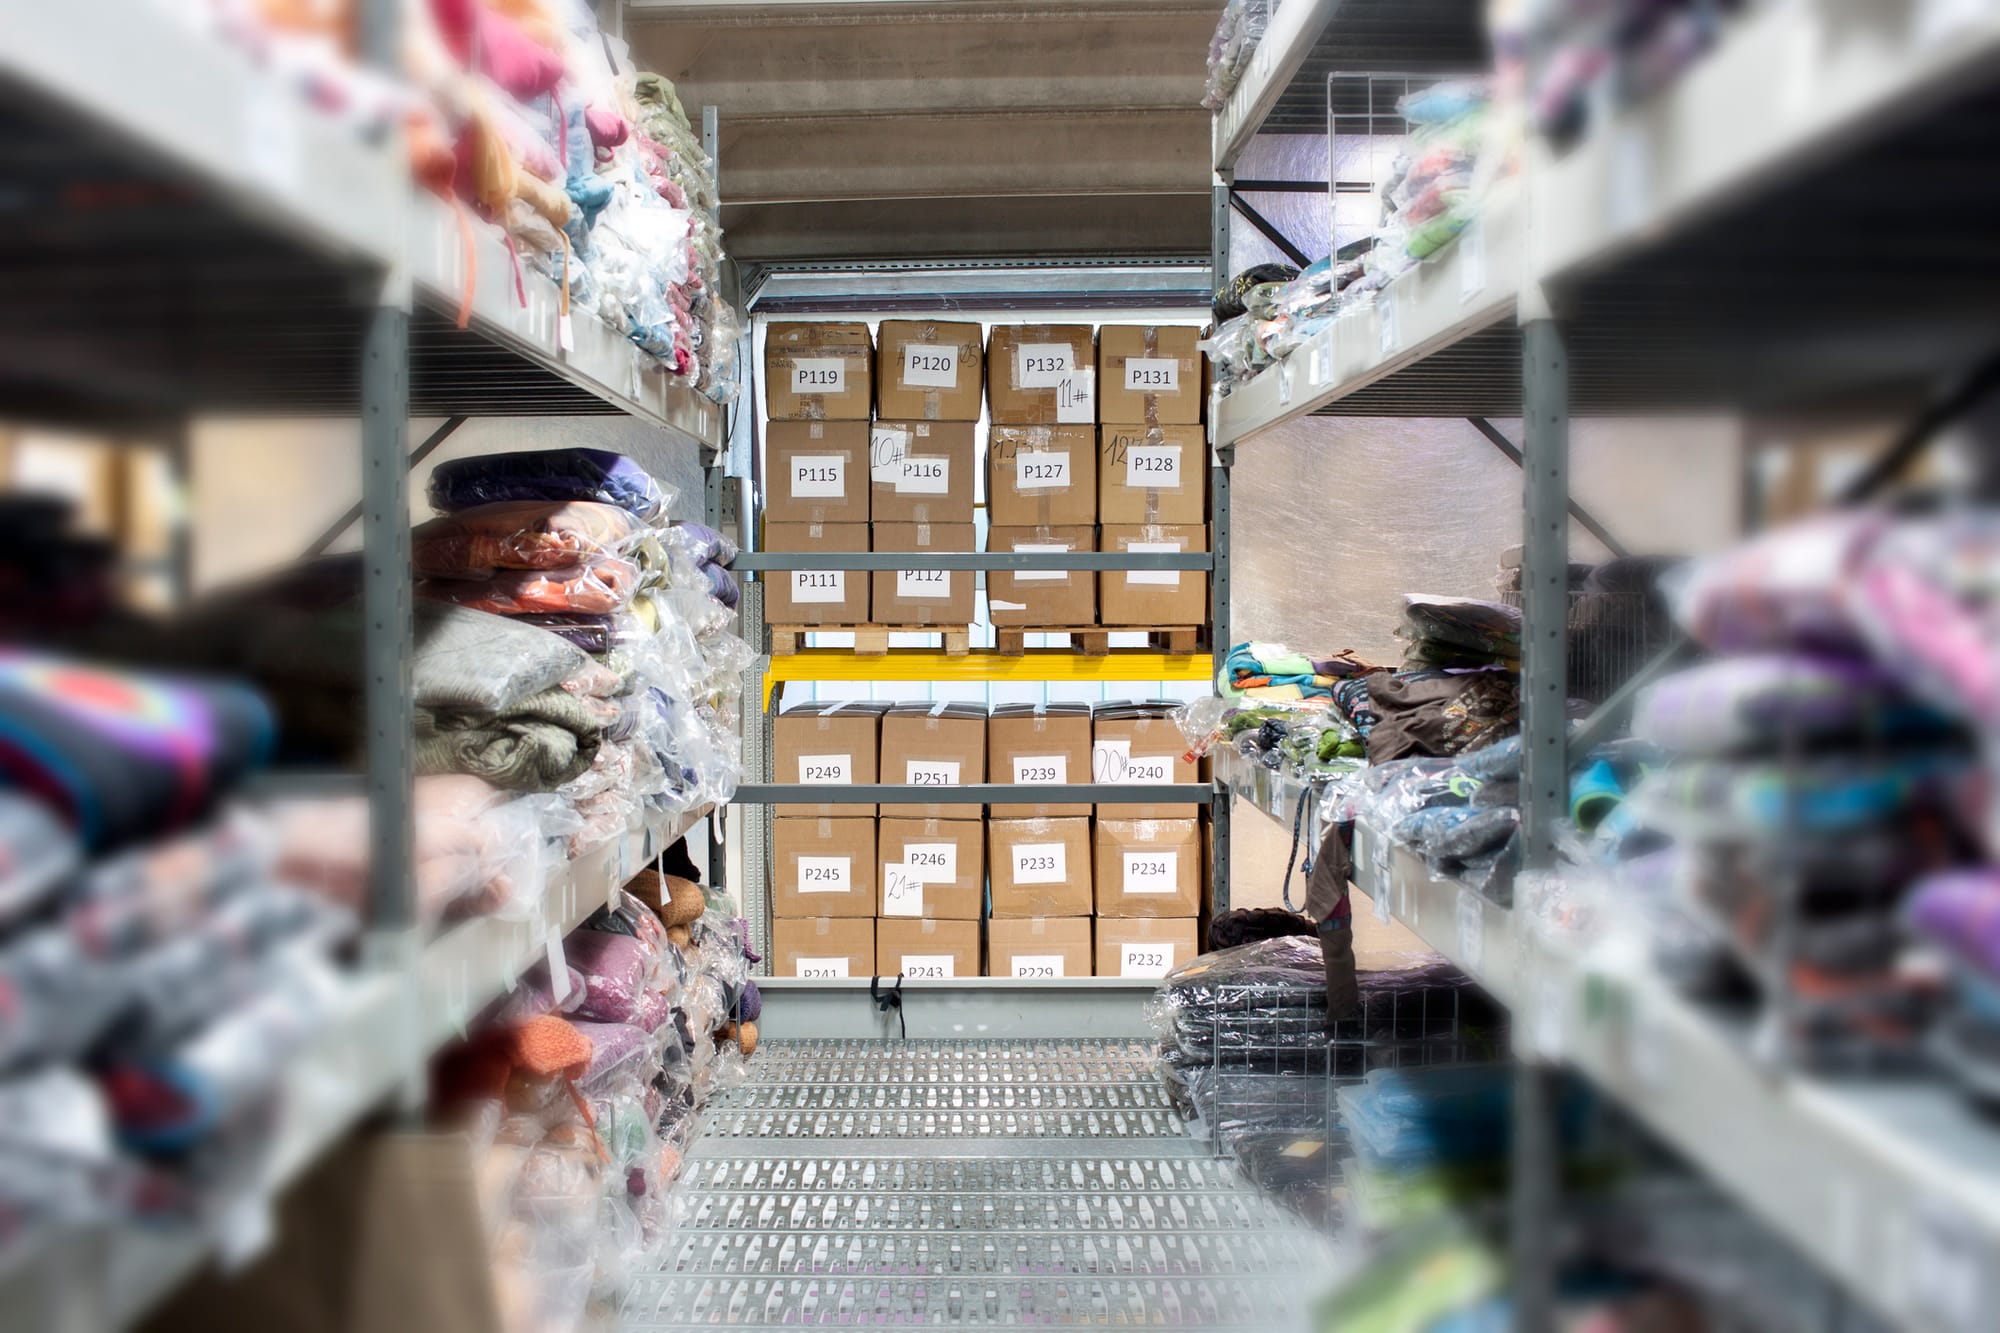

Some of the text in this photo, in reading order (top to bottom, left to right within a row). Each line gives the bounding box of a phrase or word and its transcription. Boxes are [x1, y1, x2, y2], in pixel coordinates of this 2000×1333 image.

[912, 356, 950, 371] P120
[1027, 358, 1064, 372] P132
[800, 370, 837, 384] P119
[1133, 370, 1170, 384] P131
[1059, 379, 1088, 407] 11#
[871, 436, 904, 468] 10#
[904, 464, 941, 477] P116
[1135, 458, 1173, 471] P128
[799, 468, 836, 481] P115
[1025, 465, 1062, 478] P127
[800, 574, 837, 587] P111
[905, 570, 942, 581] P112
[807, 767, 840, 778] P249
[915, 773, 947, 785] P251
[1022, 768, 1055, 780] P239
[1129, 767, 1162, 778] P240
[912, 854, 945, 865] P246
[1021, 858, 1054, 869] P233
[806, 869, 839, 880] P245
[1132, 863, 1165, 874] P234
[1129, 954, 1162, 966] P232
